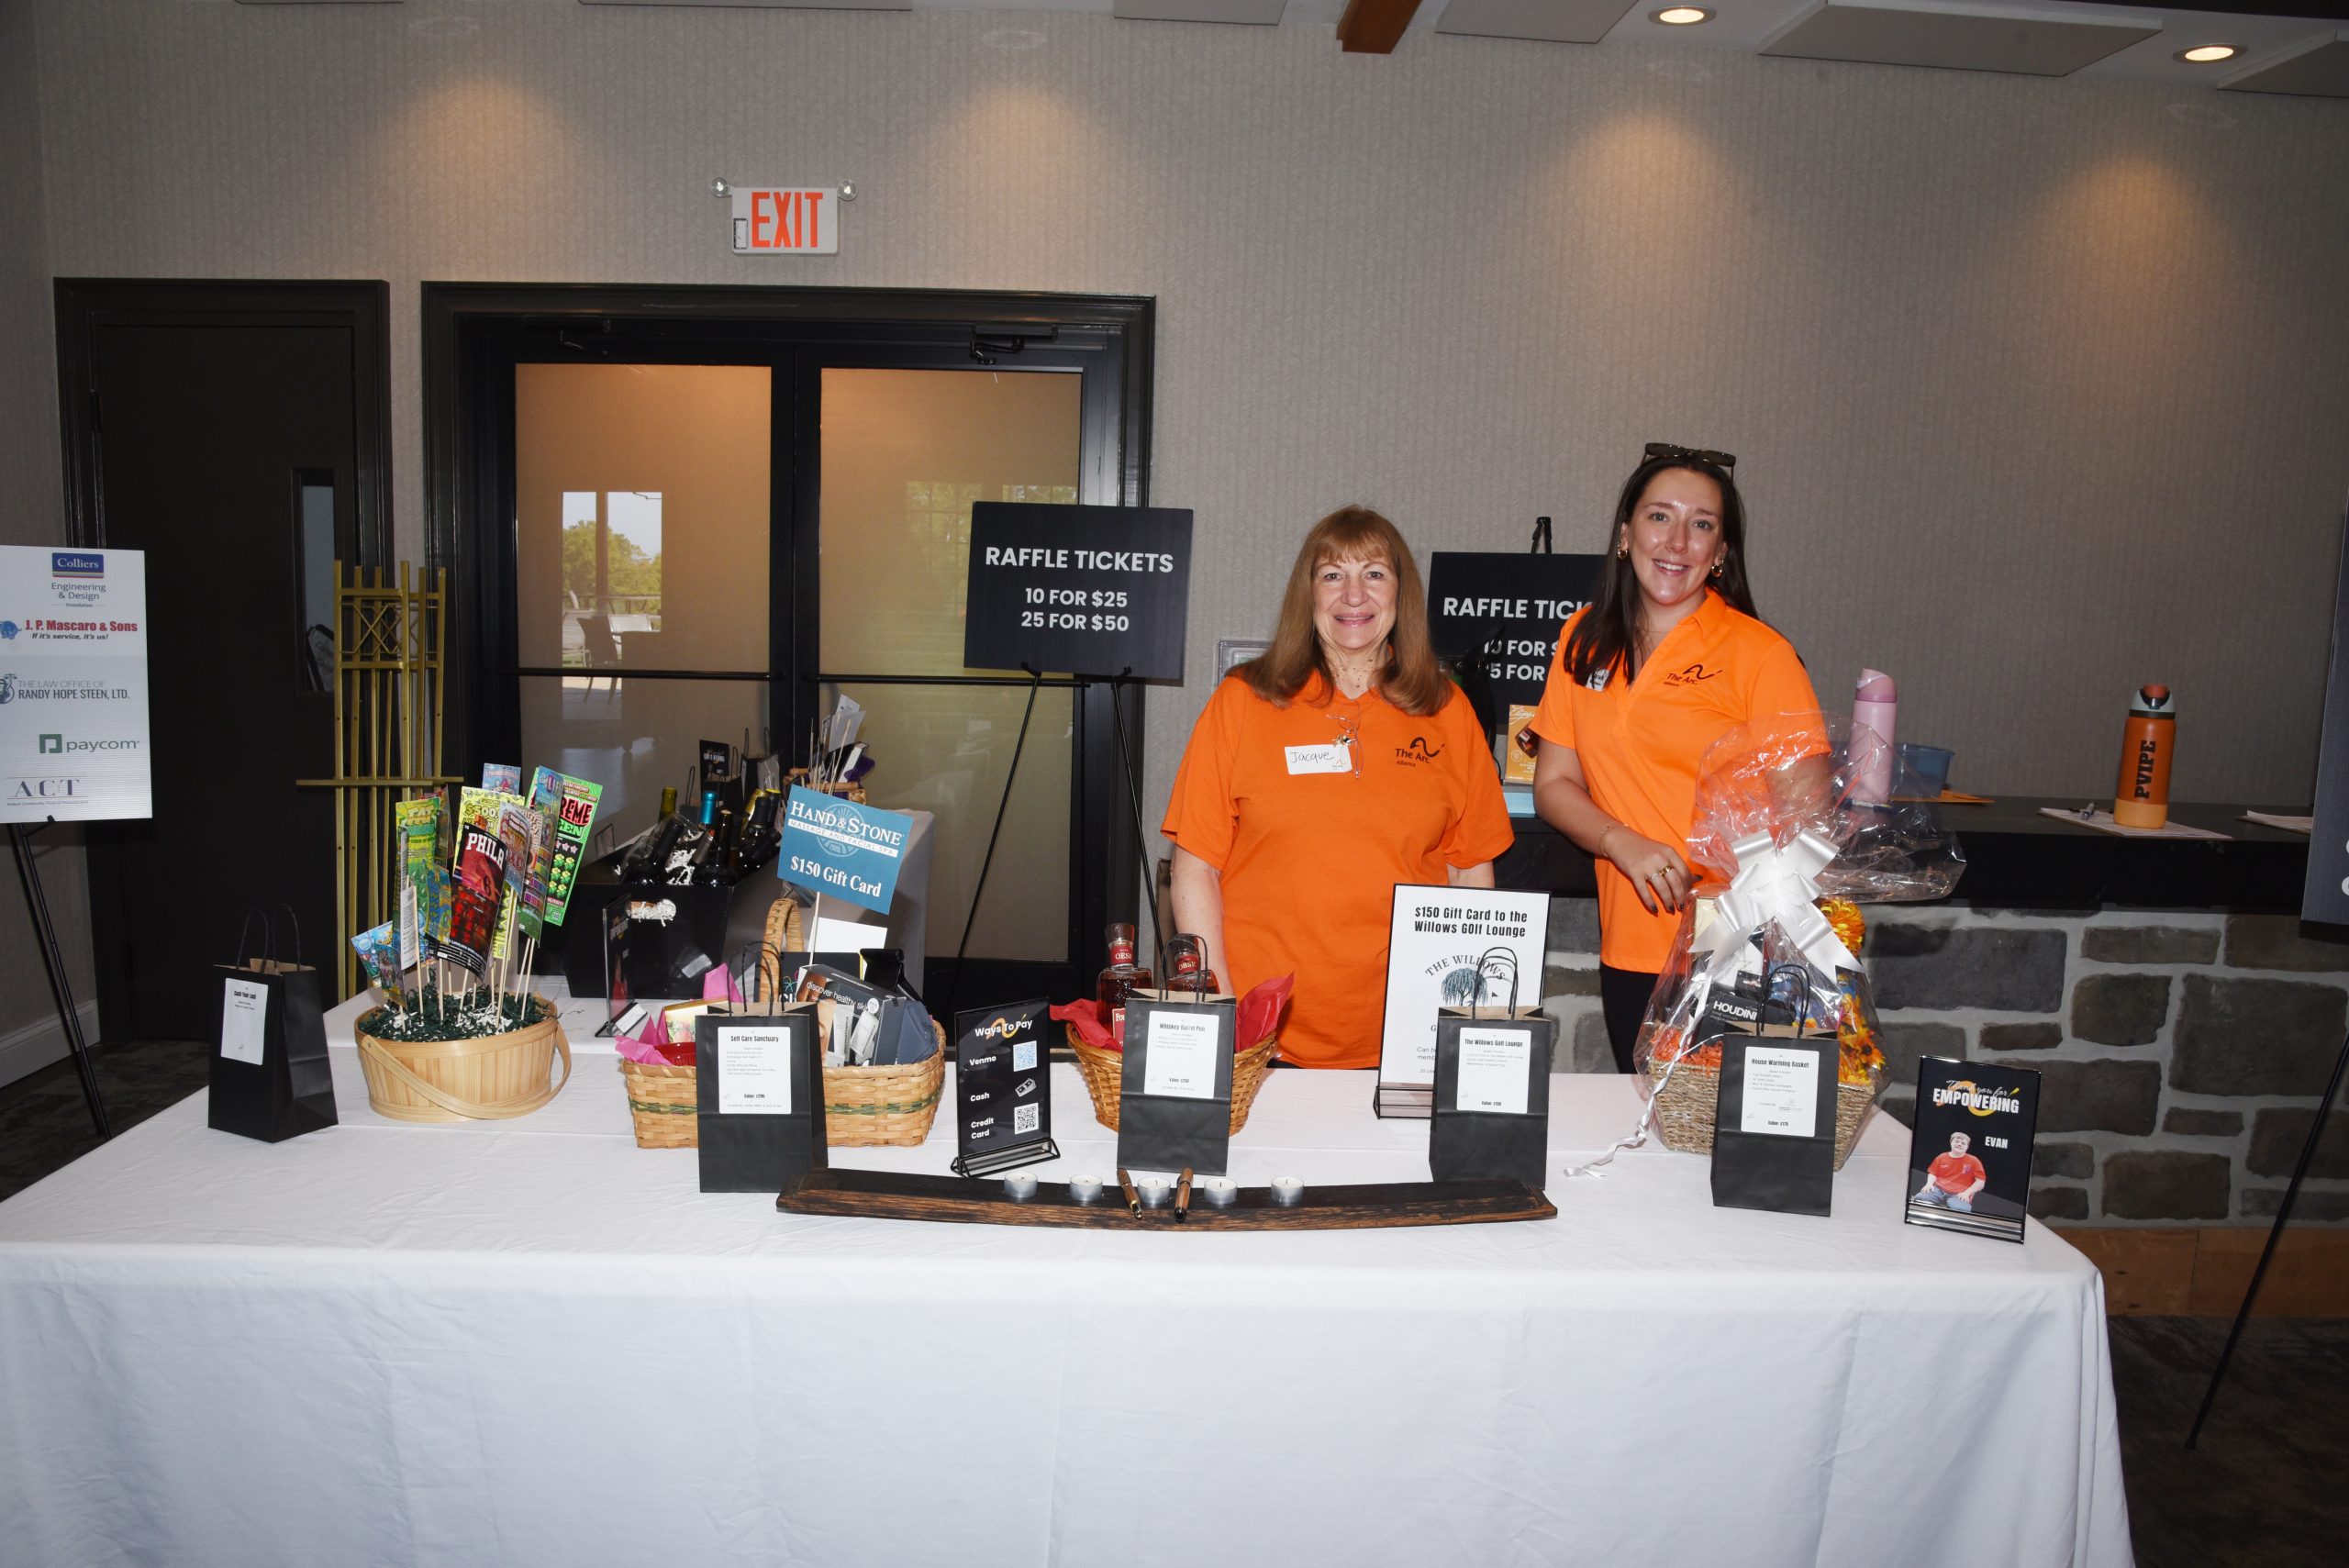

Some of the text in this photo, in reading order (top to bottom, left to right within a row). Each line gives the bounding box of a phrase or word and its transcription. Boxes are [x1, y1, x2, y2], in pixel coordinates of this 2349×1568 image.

[751, 192, 823, 248] EXIT
[57, 557, 99, 569] Colliers
[985, 547, 1174, 573] RAFFLE TICKETS
[51, 582, 106, 594] Engineering
[68, 592, 100, 602] Design
[1025, 587, 1128, 608] 10 FOR $25
[1443, 597, 1529, 619] RAFFLE
[26, 620, 139, 632] J. P. Mascaro & Sons
[1021, 611, 1130, 632] 25 FOR $50
[1507, 639, 1547, 657] FOR
[1486, 662, 1545, 682] 5 FOR
[18, 680, 106, 688] THE LAW OFFICE OF
[18, 689, 130, 701] RANDY HOPE STEEN, LTD.
[66, 740, 137, 752] paycom
[1395, 748, 1413, 759] The
[1289, 750, 1335, 764] Jacque
[2134, 740, 2156, 799] PVIPE
[790, 820, 894, 855] MASSAGE AND FACIAL SPA
[790, 856, 882, 897] $150 Gift Card
[1415, 906, 1528, 923] $150 Gift Card to the
[1414, 920, 1457, 934] Willows
[1486, 925, 1526, 938] Lounge
[1425, 955, 1506, 980] THE WILLOWS
[807, 981, 833, 998] discover
[833, 990, 857, 1007] healthy
[1713, 1001, 1757, 1020] HOUDINI
[975, 1019, 1033, 1037] Ways To Pay
[969, 1055, 997, 1066] Venmo
[970, 1092, 990, 1102] Cash
[1932, 1087, 2020, 1114] EMPOWERING
[971, 1117, 995, 1129] Credit
[971, 1129, 990, 1140] Card
[1985, 1136, 2009, 1149] EVAN
